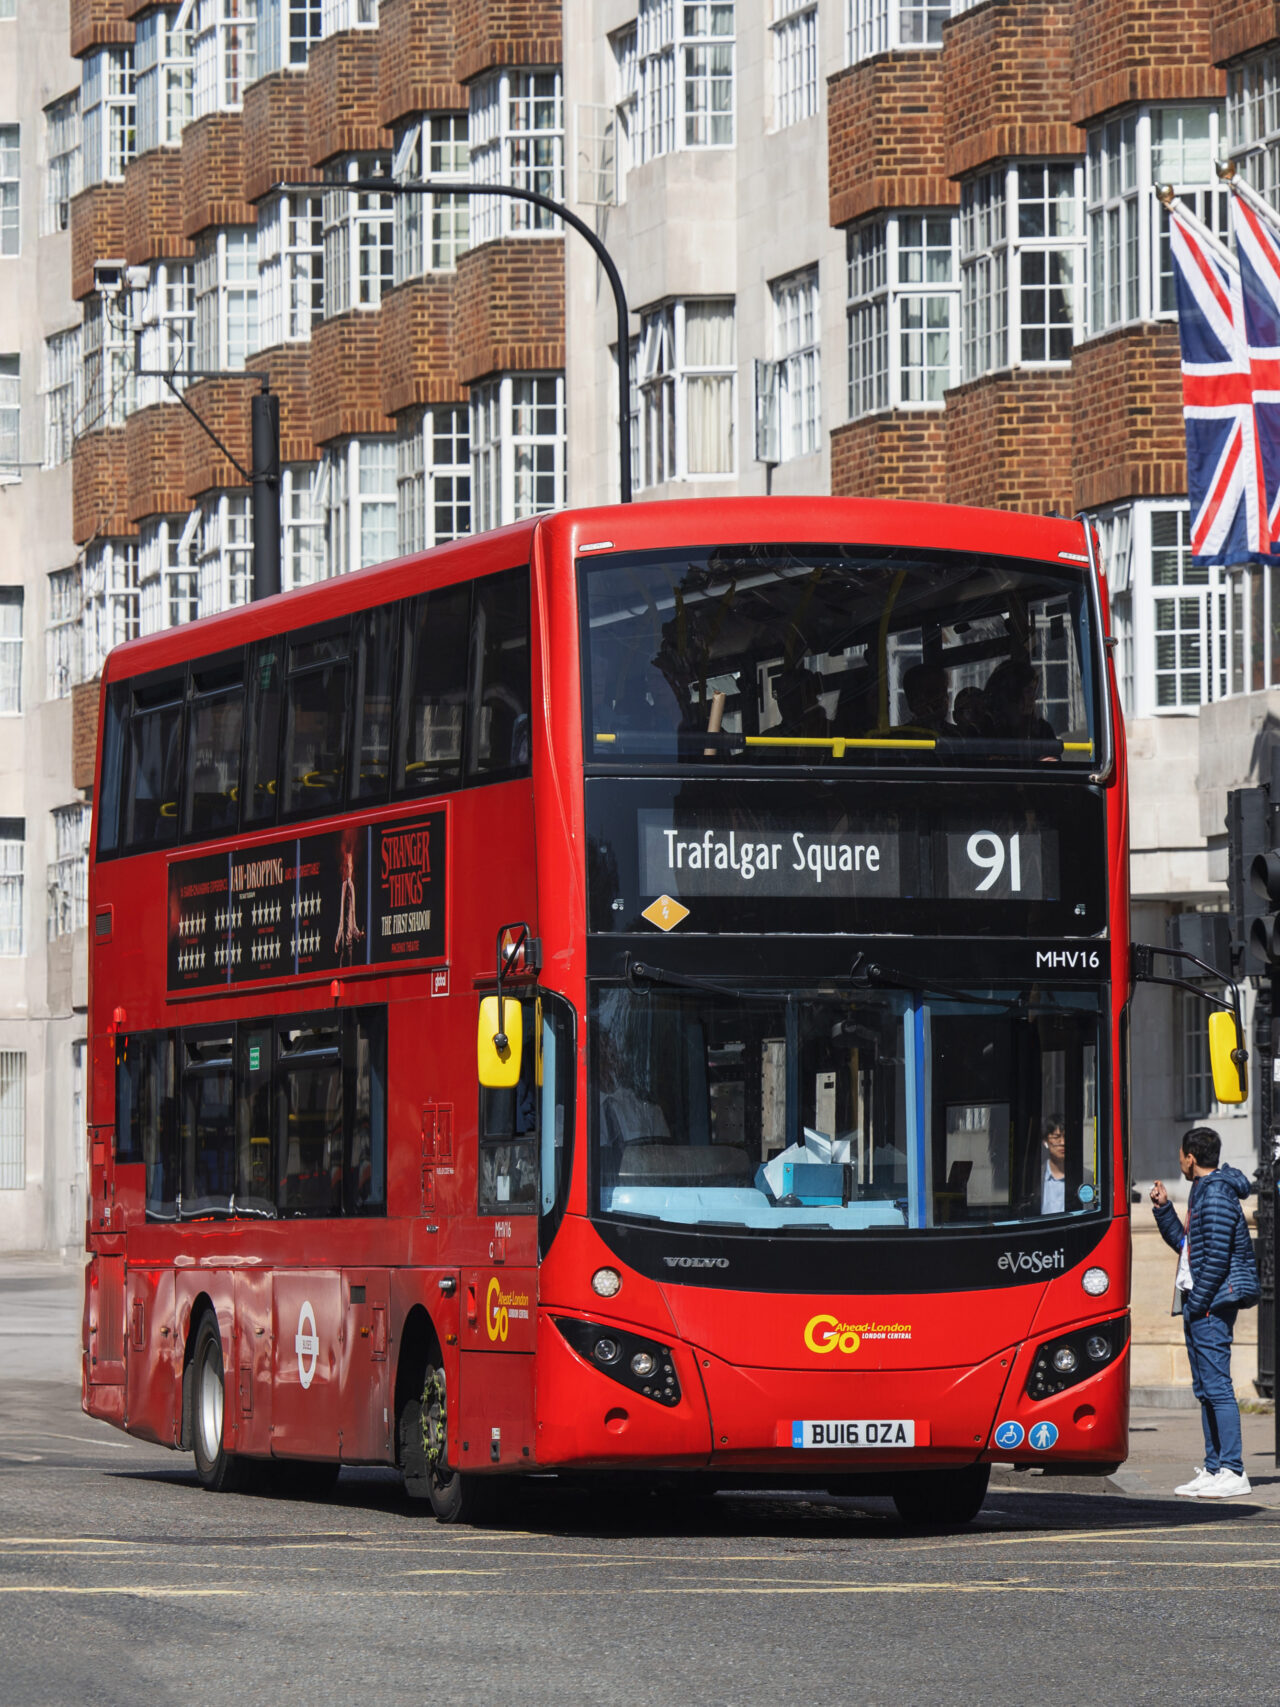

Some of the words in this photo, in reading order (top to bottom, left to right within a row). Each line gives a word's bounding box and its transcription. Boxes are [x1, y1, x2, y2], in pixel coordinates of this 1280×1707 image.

[381, 831, 431, 880] STRANGER
[663, 829, 782, 879] Trafalgar
[792, 832, 880, 882] Square
[967, 830, 1021, 891] 91
[389, 871, 424, 908] THINGS
[381, 914, 392, 936] THE
[392, 912, 408, 935] FIRST
[408, 909, 431, 933] SHADOW
[1036, 951, 1100, 968] MHV16
[495, 1221, 511, 1238] MHV16
[663, 1257, 730, 1268] VOLVO
[486, 1277, 508, 1342] Go
[498, 1290, 529, 1306] Ahead-London
[804, 1314, 860, 1354] Go
[835, 1322, 912, 1333] Ahead-London
[812, 1424, 858, 1444] BU16
[866, 1423, 907, 1443] OZA
